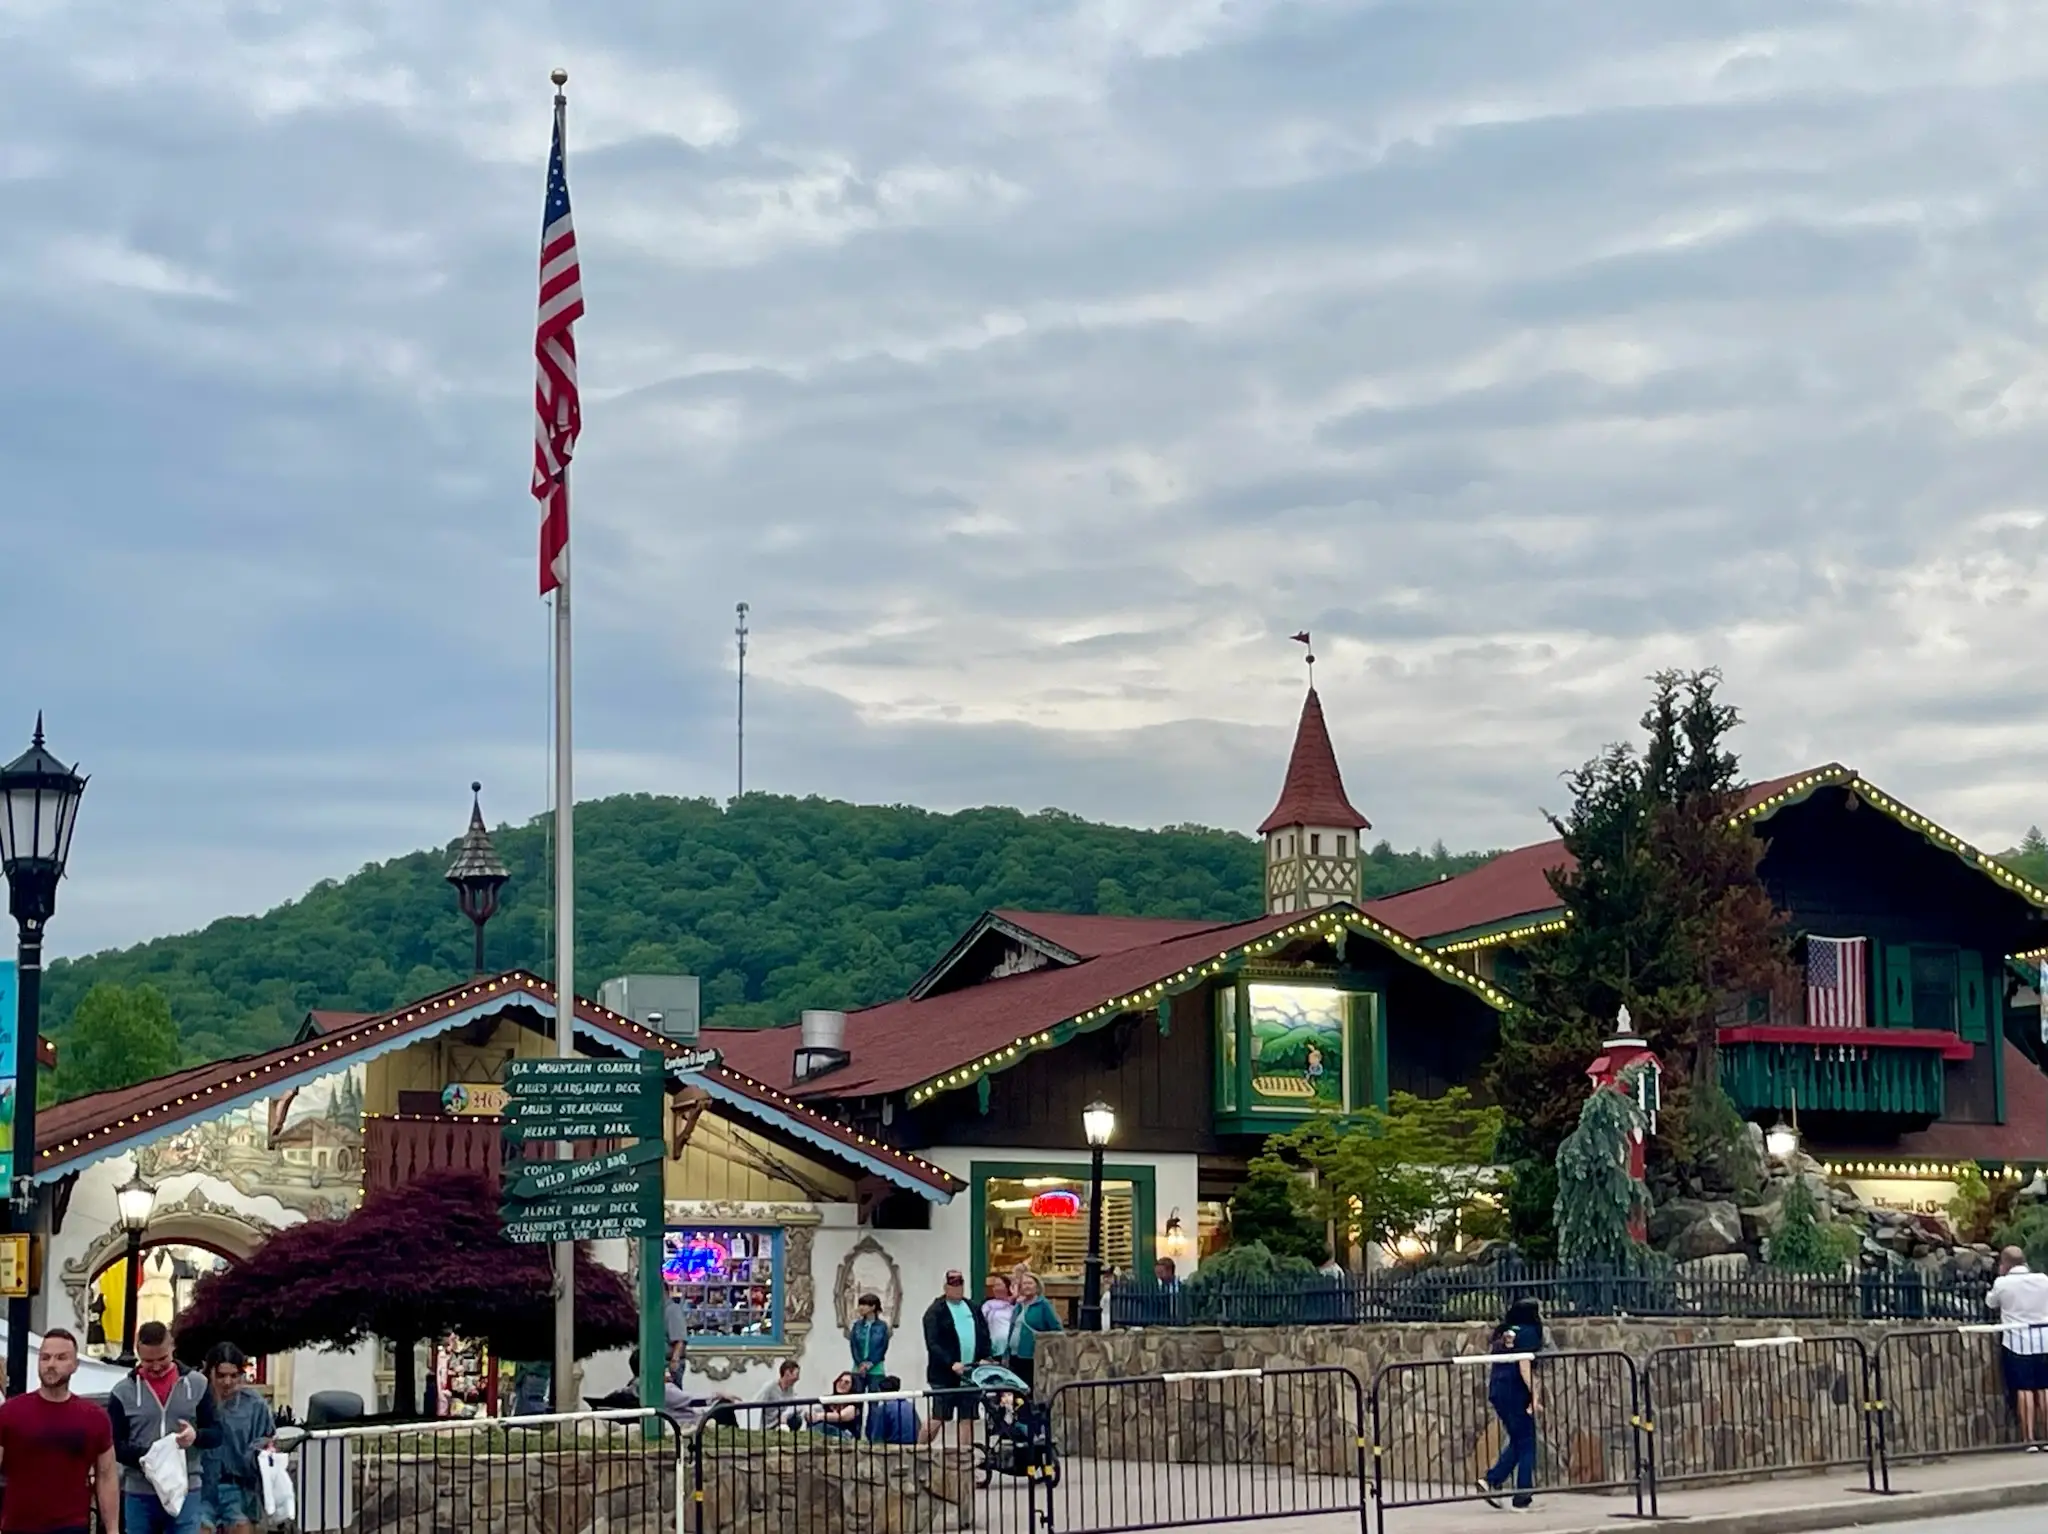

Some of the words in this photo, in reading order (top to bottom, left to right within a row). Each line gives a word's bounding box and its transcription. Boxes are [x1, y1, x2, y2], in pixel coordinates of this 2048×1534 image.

[534, 1063, 593, 1075] MOUNTAIN
[597, 1063, 642, 1075] COASTER
[550, 1082, 611, 1096] MARGARITA
[615, 1082, 642, 1094] DECK
[559, 1102, 624, 1116] STEAKHOUSE
[522, 1125, 557, 1138] HELEN
[563, 1124, 597, 1136] WATER
[603, 1122, 632, 1135] PARK
[535, 1172, 566, 1189] WILD
[571, 1161, 602, 1180] HOGS
[606, 1152, 629, 1169] BBQ
[611, 1182, 640, 1194] SHOP
[520, 1204, 563, 1218] ALPINE
[571, 1203, 601, 1216] BREW
[609, 1202, 639, 1214] DECK
[571, 1218, 621, 1231] CARAMEL
[623, 1216, 648, 1229] CORN
